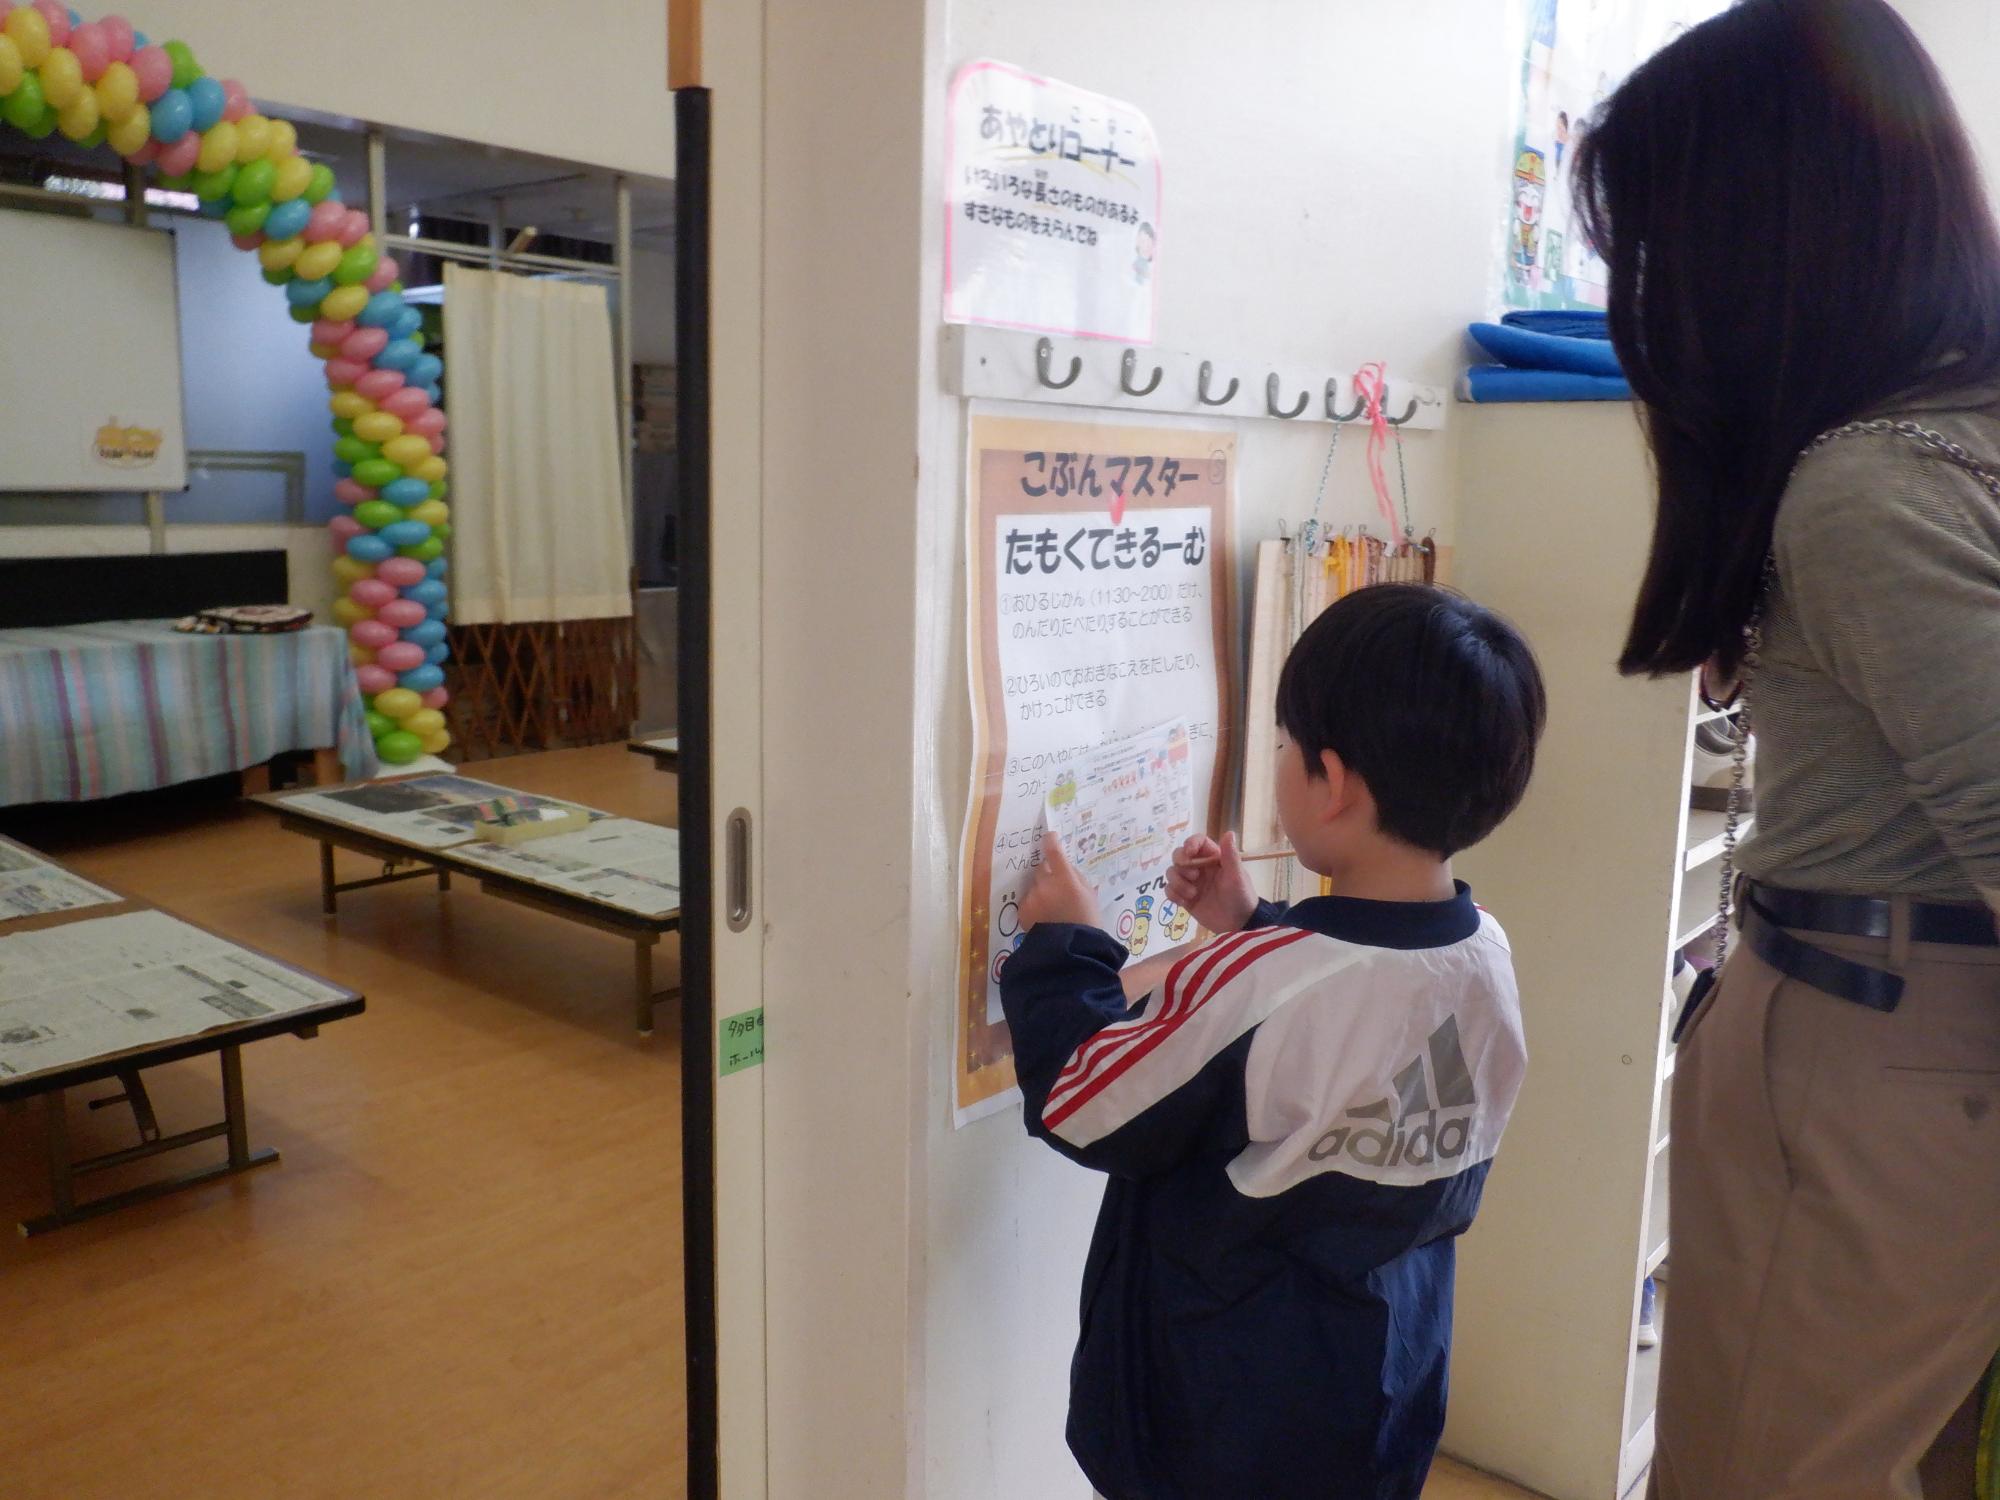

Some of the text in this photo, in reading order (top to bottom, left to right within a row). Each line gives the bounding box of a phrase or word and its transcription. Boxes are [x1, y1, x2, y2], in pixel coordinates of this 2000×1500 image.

[980, 104, 1136, 173] あやとりコーナー
[964, 200, 1098, 247] すきなものをえらんでね
[1020, 451, 1200, 497] こぶんマスター
[1005, 525, 1206, 575] たもくてきるーむ
[1020, 689, 1108, 721] かけっこができる
[1308, 1109, 1472, 1168] adida
